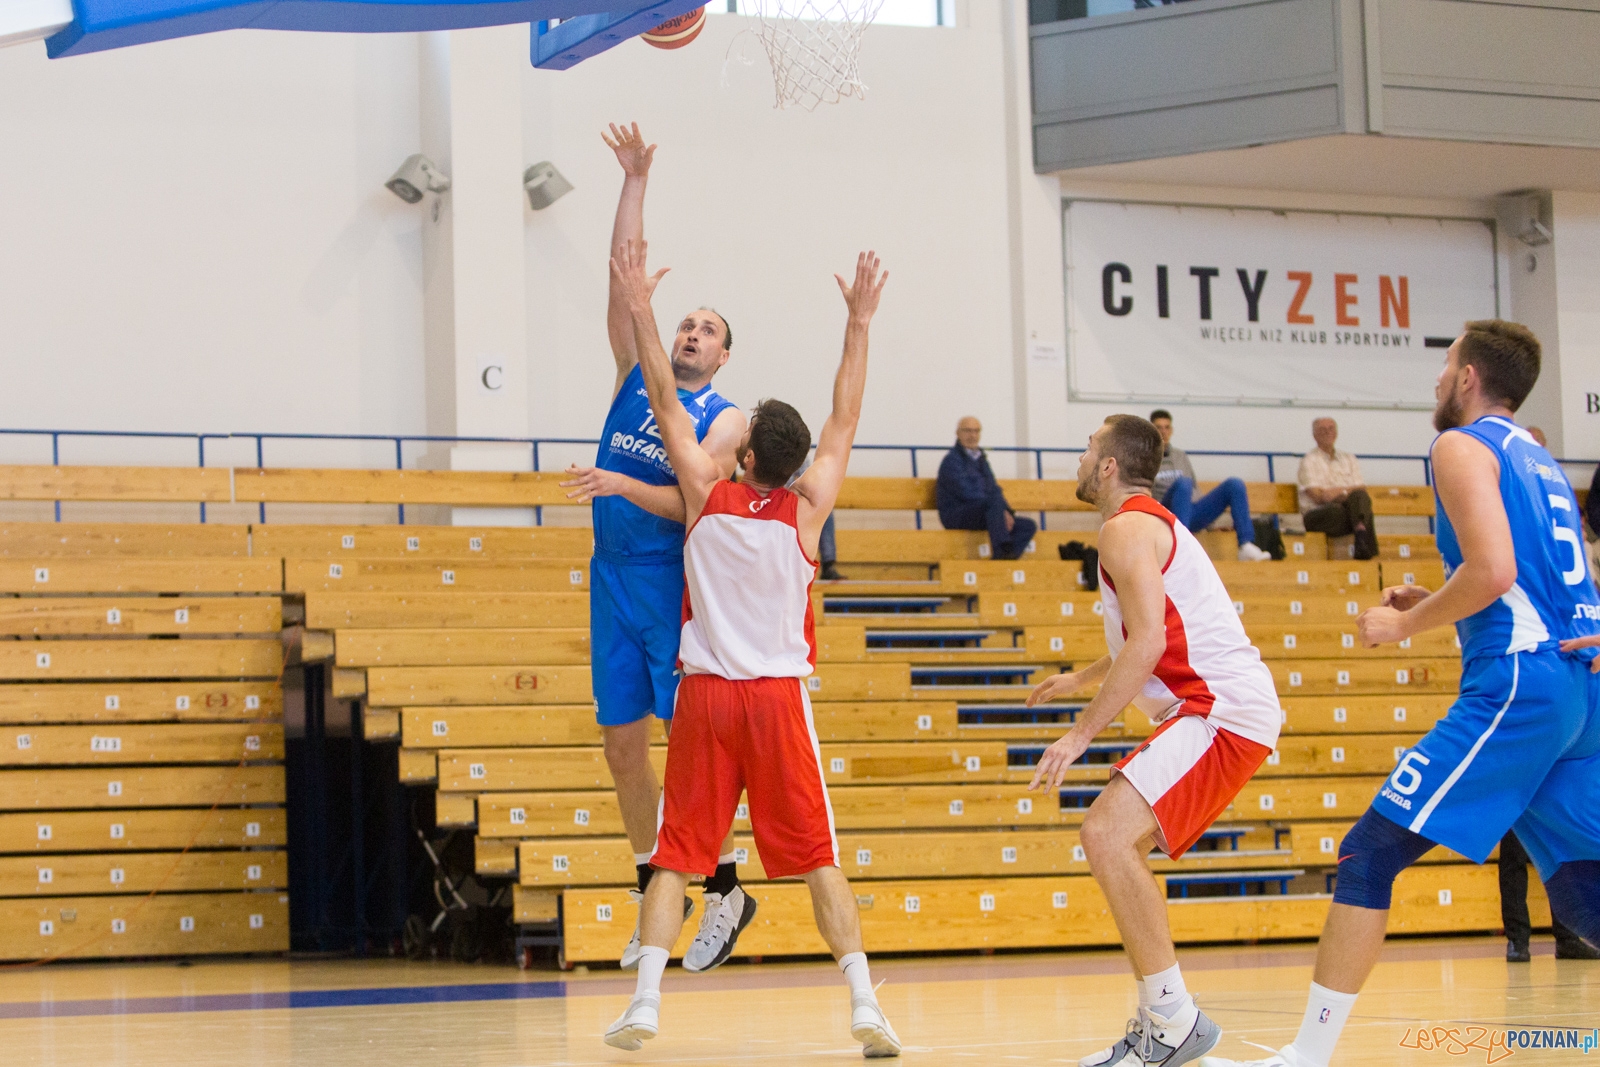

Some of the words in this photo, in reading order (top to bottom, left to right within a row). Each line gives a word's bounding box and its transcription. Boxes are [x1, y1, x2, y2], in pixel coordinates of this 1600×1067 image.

[1102, 262, 1410, 329] CITYZEN
[1291, 330, 1327, 344] KLUB
[1335, 331, 1411, 347] SPORTOWY
[481, 365, 502, 390] C
[1586, 392, 1600, 414] B
[343, 536, 353, 546] 17
[408, 539, 418, 549] 16
[471, 539, 481, 549] 15
[332, 566, 342, 576] 16
[444, 572, 454, 582] 14
[571, 572, 581, 582] 12
[435, 723, 447, 733] 16
[833, 760, 843, 770] 11
[472, 766, 484, 776] 16
[1391, 751, 1430, 795] 6
[513, 810, 526, 821] 16
[736, 806, 747, 816] 13
[577, 812, 589, 823] 15
[737, 849, 746, 861] 15
[859, 852, 870, 863] 12
[555, 858, 568, 868] 16
[907, 898, 918, 910] 12
[983, 897, 993, 907] 11
[599, 907, 610, 918] 16
